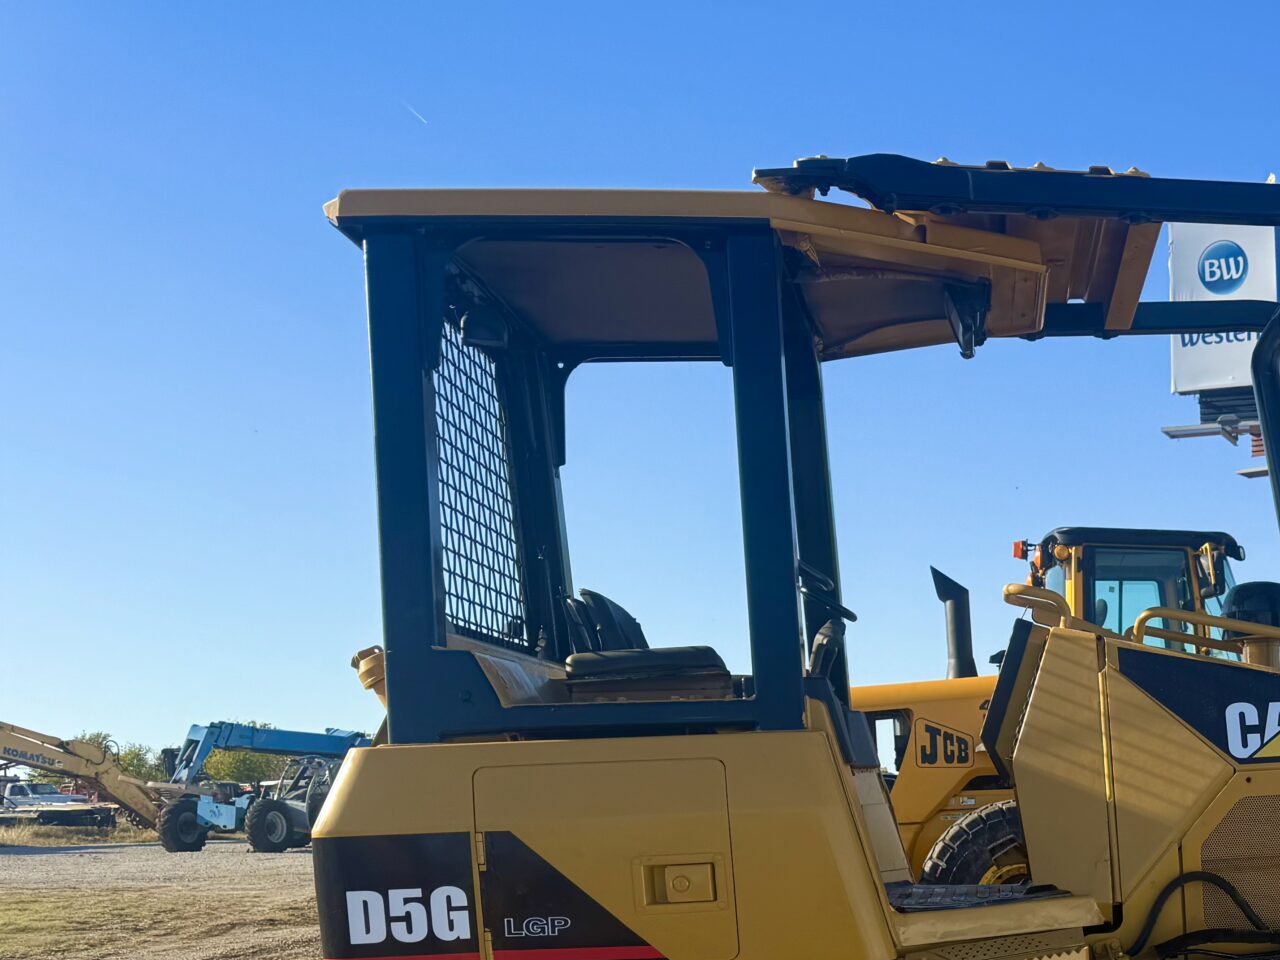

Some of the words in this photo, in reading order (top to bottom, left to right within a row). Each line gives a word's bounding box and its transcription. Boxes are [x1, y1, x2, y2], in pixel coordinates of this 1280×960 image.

[1204, 256, 1244, 282] BW
[3, 746, 55, 766] KOMATSU
[920, 723, 969, 765] JCB
[345, 886, 471, 945] D5G
[504, 917, 571, 937] LGP
